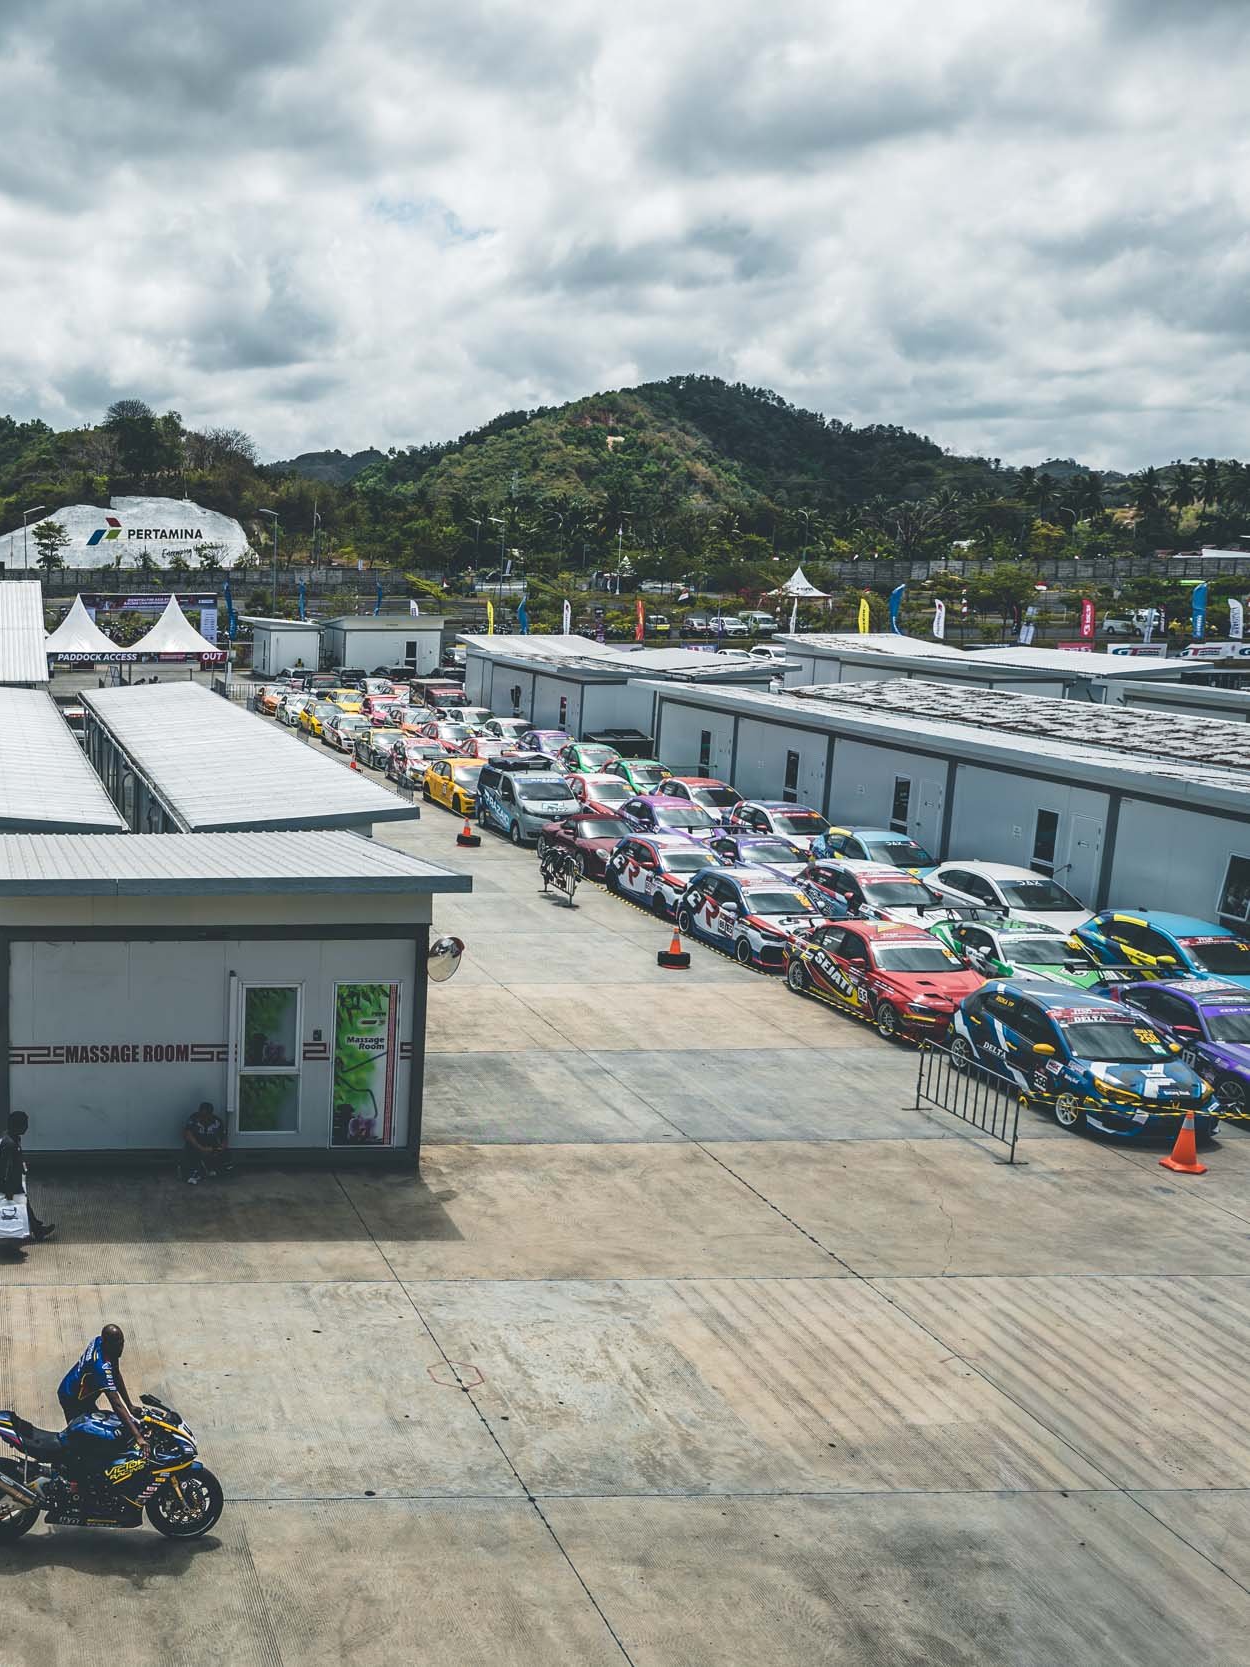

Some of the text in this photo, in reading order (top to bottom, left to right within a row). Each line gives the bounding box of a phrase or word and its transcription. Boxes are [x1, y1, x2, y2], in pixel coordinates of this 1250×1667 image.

[127, 529, 203, 539] PERTAMINA
[57, 653, 137, 661] PADDOCK ACCESS
[202, 652, 223, 661] OUT
[814, 951, 854, 996] SEJATI
[347, 1036, 384, 1044] Massage
[65, 1044, 189, 1063] MASSAGE ROOM
[983, 1042, 1006, 1059] DELTA
